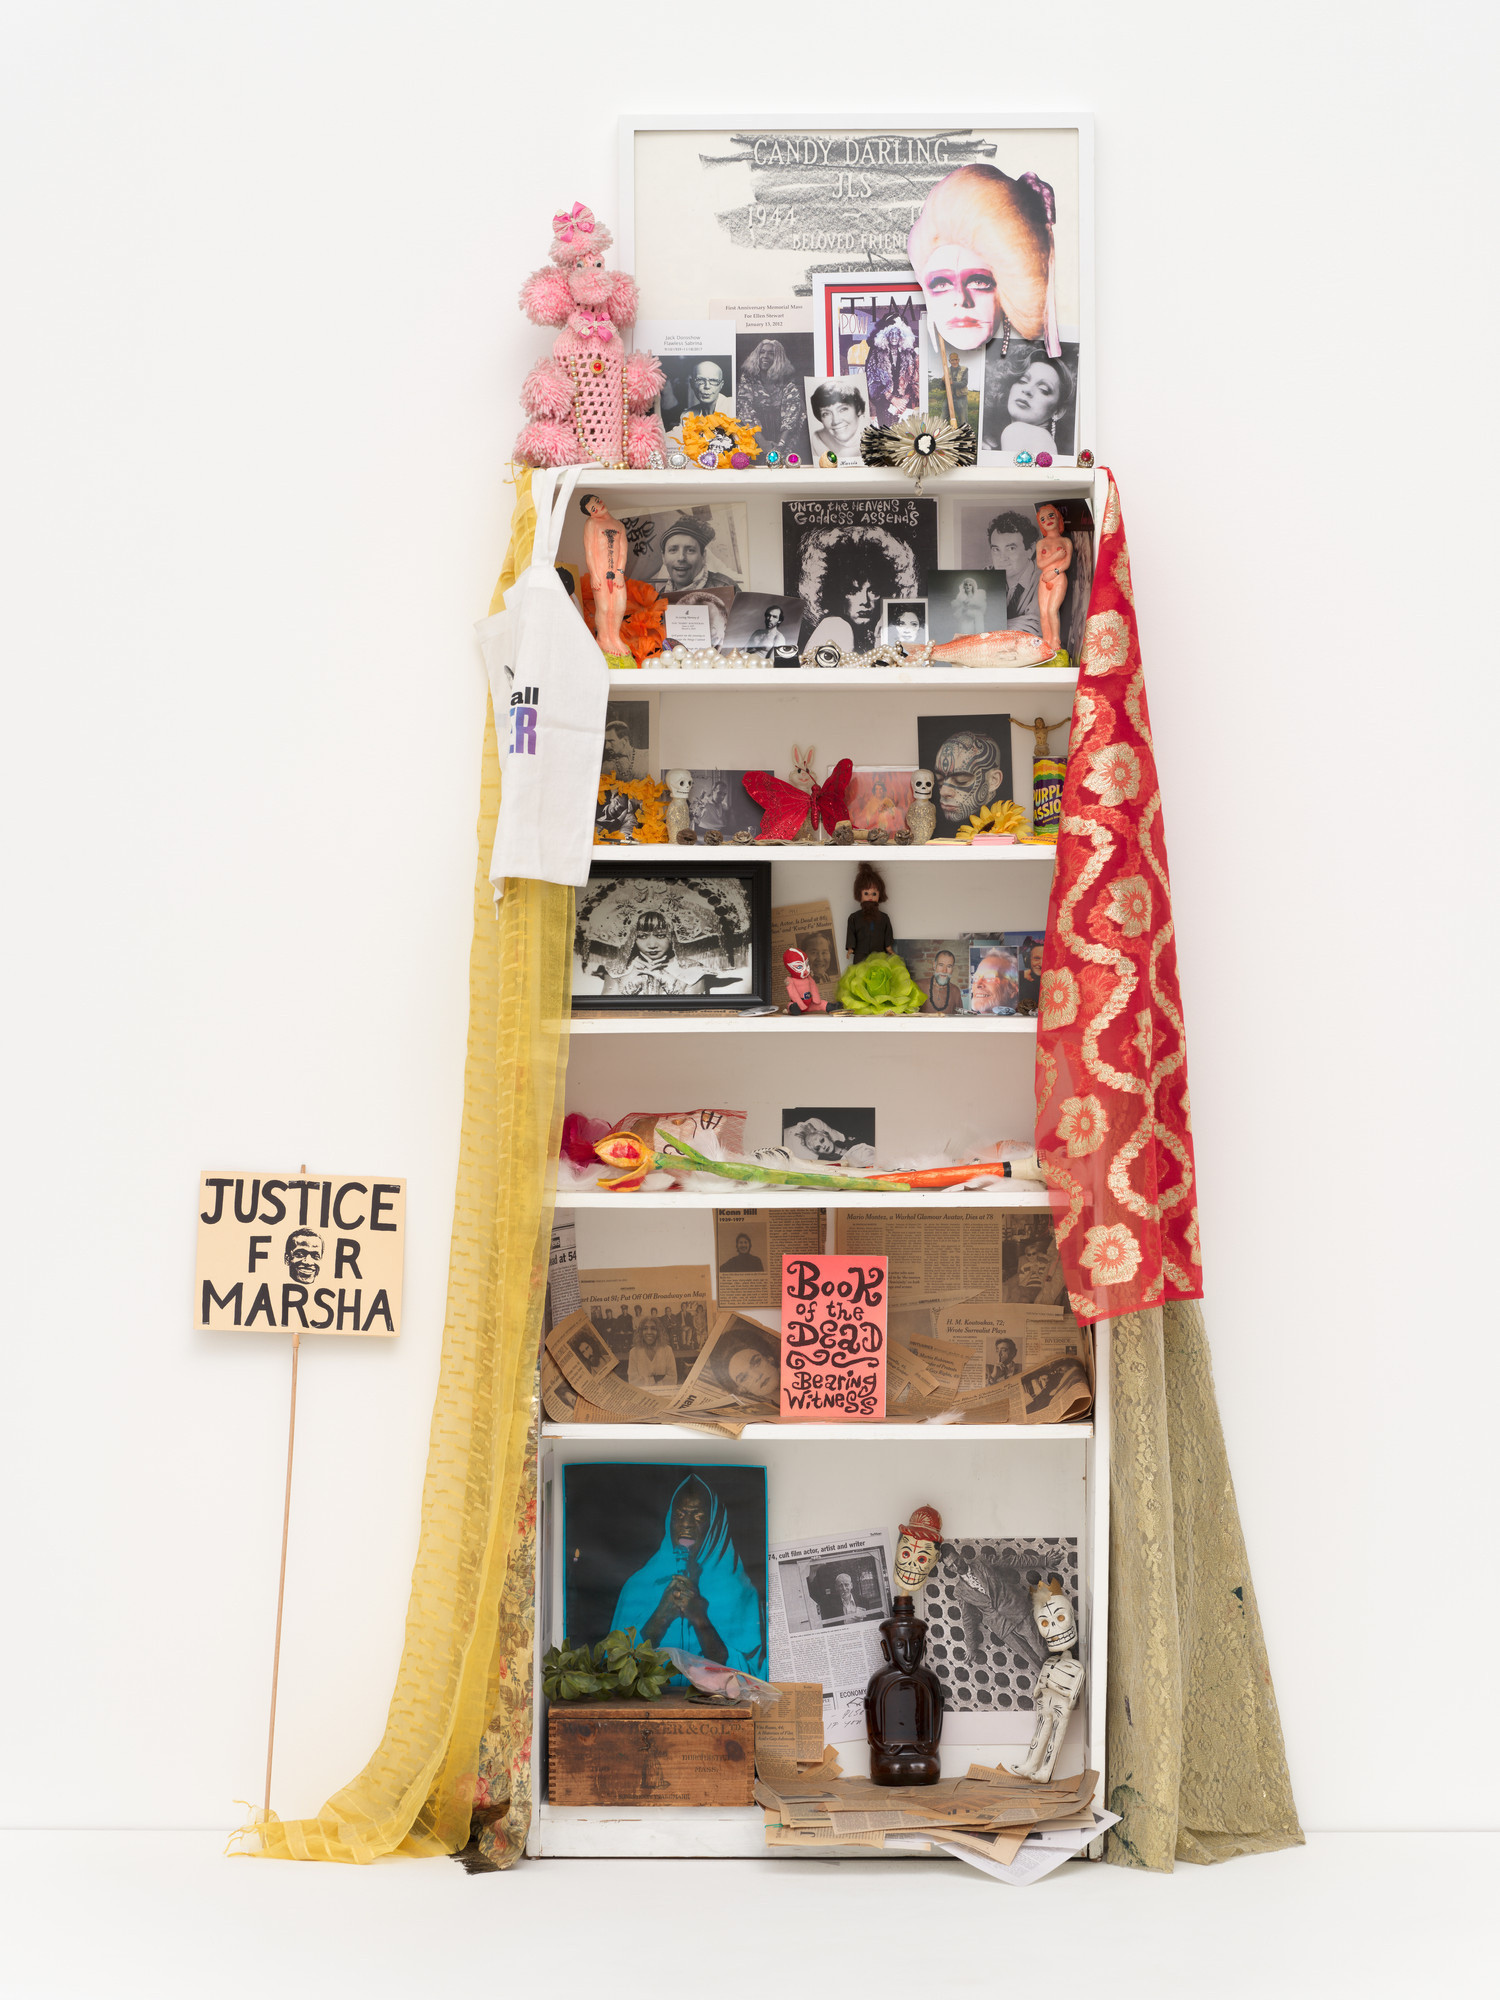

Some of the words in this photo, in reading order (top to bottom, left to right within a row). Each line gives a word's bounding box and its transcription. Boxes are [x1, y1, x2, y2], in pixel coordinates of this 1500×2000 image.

[754, 139, 832, 165] CANDY
[846, 139, 949, 165] DARLING
[832, 172, 873, 199] JLS
[748, 206, 797, 226] 1944
[793, 233, 854, 250] BELOVED
[840, 296, 917, 322] TIM
[789, 502, 822, 512] UNTO
[828, 501, 849, 511] the
[201, 1178, 401, 1231] JUSTICE
[865, 1213, 888, 1221] Montez,
[559, 1252, 567, 1263] at
[201, 1279, 394, 1332] MARSHA
[653, 1292, 683, 1300] Broadway
[796, 1300, 817, 1322] of
[826, 1301, 864, 1322] the
[778, 1551, 790, 1559] cult
[790, 1549, 802, 1557] film
[803, 1548, 819, 1556] actor,
[820, 1544, 836, 1552] artist
[837, 1542, 848, 1550] and
[849, 1540, 866, 1548] writer
